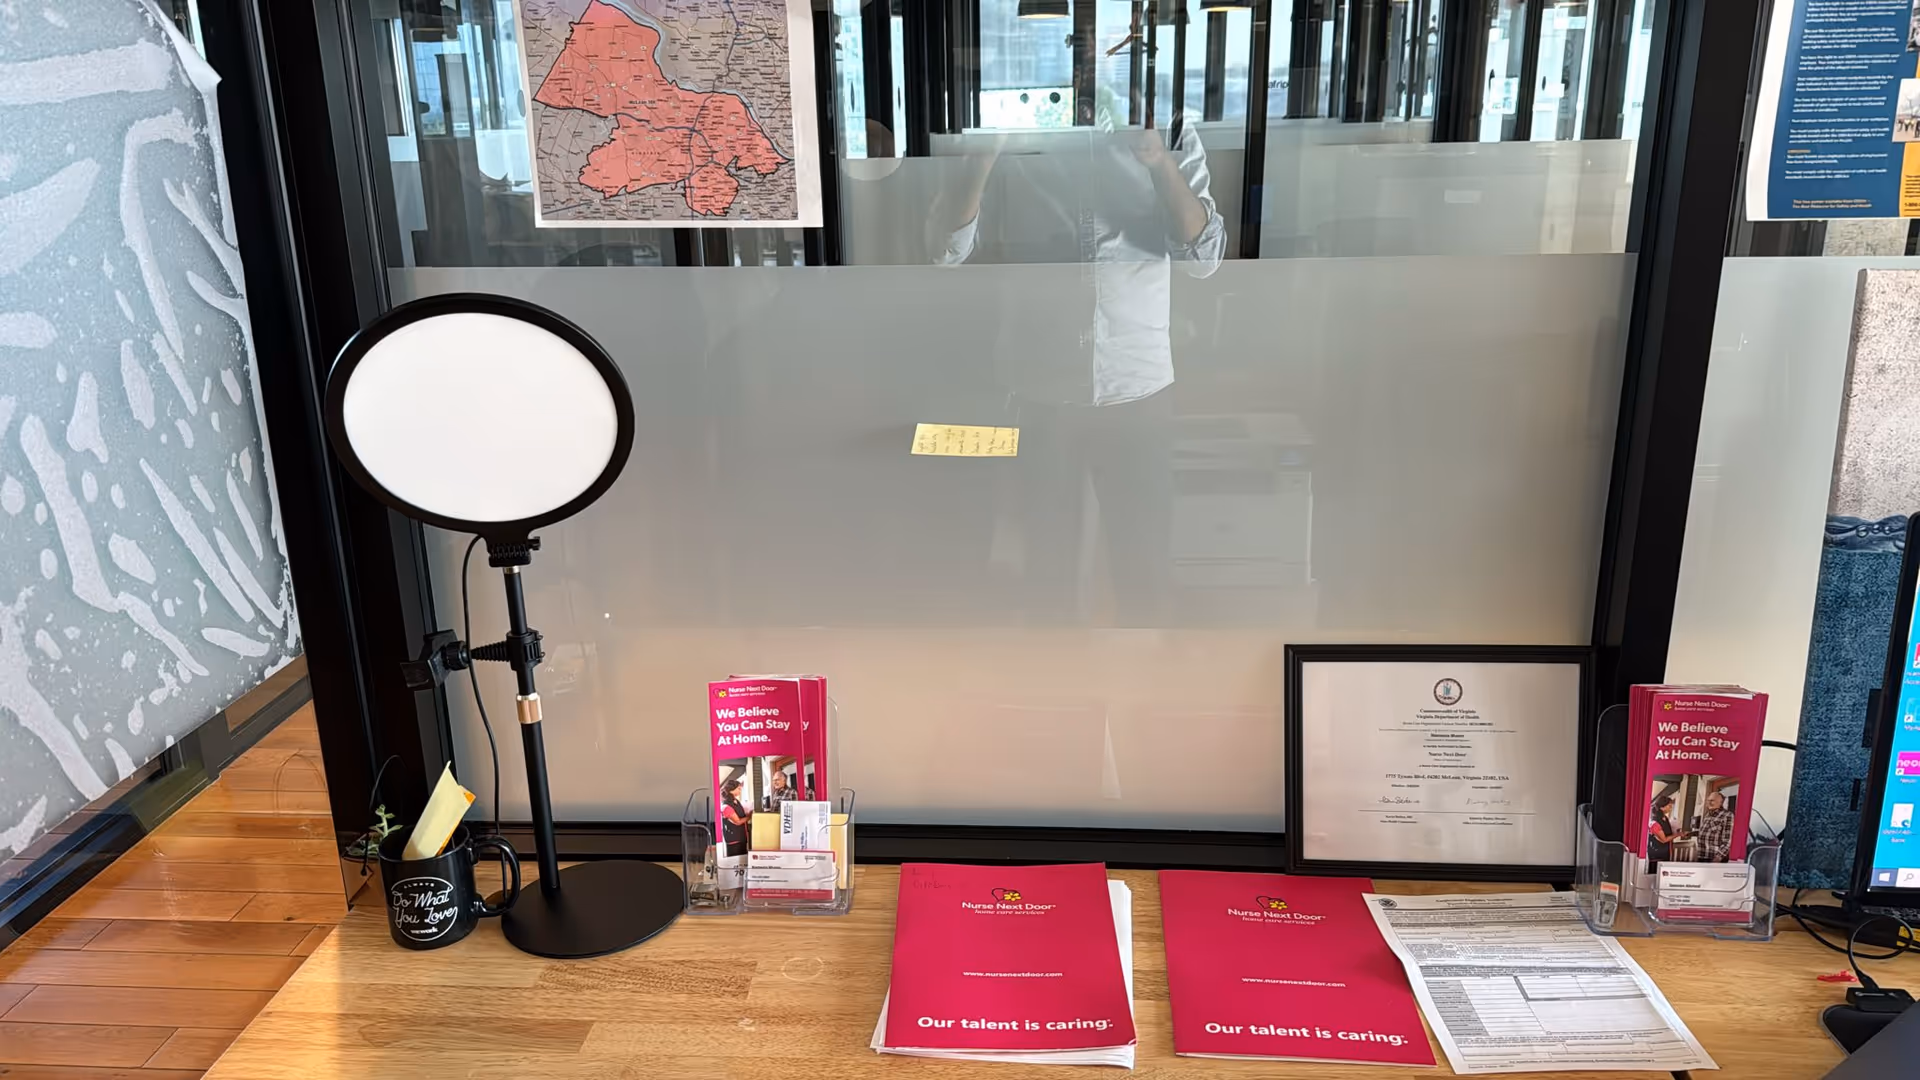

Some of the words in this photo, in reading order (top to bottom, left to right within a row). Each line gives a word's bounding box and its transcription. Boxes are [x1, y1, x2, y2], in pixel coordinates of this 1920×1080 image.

[716, 708, 736, 719] We
[738, 706, 780, 717] Believe
[716, 722, 739, 732] You
[741, 720, 764, 730] Can
[765, 719, 791, 731] Stay
[1658, 721, 1678, 732] We
[1681, 722, 1728, 734] Believe
[717, 735, 731, 746] At
[733, 733, 772, 745] Home.
[1657, 735, 1679, 746] You
[1682, 736, 1707, 746] Can
[1709, 737, 1740, 751] Stay
[1655, 749, 1670, 760] At
[1671, 749, 1713, 761] Home.
[783, 814, 792, 834] VDH
[392, 890, 411, 907] Do
[410, 887, 451, 905] What
[962, 901, 994, 910] Nurse
[996, 902, 1023, 910] Next
[1025, 902, 1053, 910] Door
[392, 906, 420, 928] You
[424, 906, 458, 925] Love
[1227, 907, 1261, 918] Nurse
[1263, 910, 1291, 919] Next
[1293, 912, 1323, 921] Door
[962, 970, 1063, 978] www.nursenextdoor.com
[1241, 976, 1346, 987] www.nursenextdoor.com
[917, 1016, 955, 1029] Our
[960, 1017, 1018, 1030] talent
[1024, 1018, 1040, 1031] is
[1205, 1022, 1243, 1034] Our
[1249, 1024, 1310, 1038] talent
[1315, 1027, 1331, 1039] is
